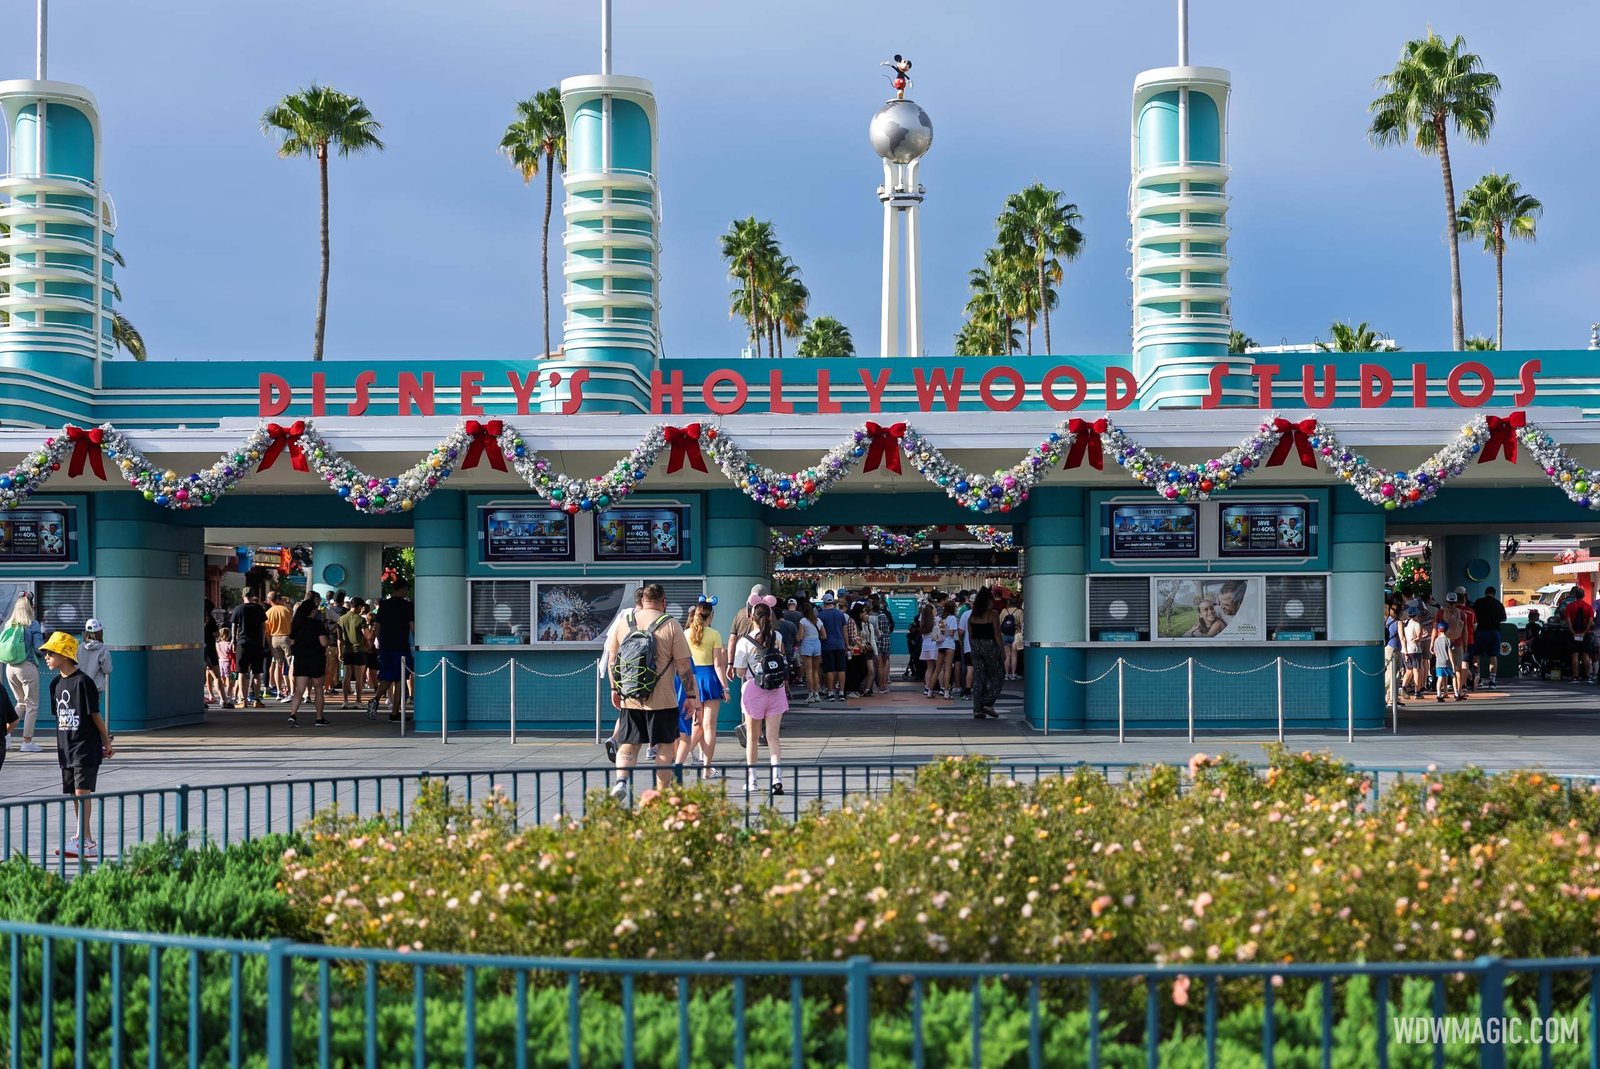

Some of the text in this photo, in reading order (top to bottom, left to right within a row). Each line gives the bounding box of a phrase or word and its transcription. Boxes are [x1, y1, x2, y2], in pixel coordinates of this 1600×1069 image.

[259, 360, 1542, 416] DISNEY'S HOLLYWOOD STUDIOS
